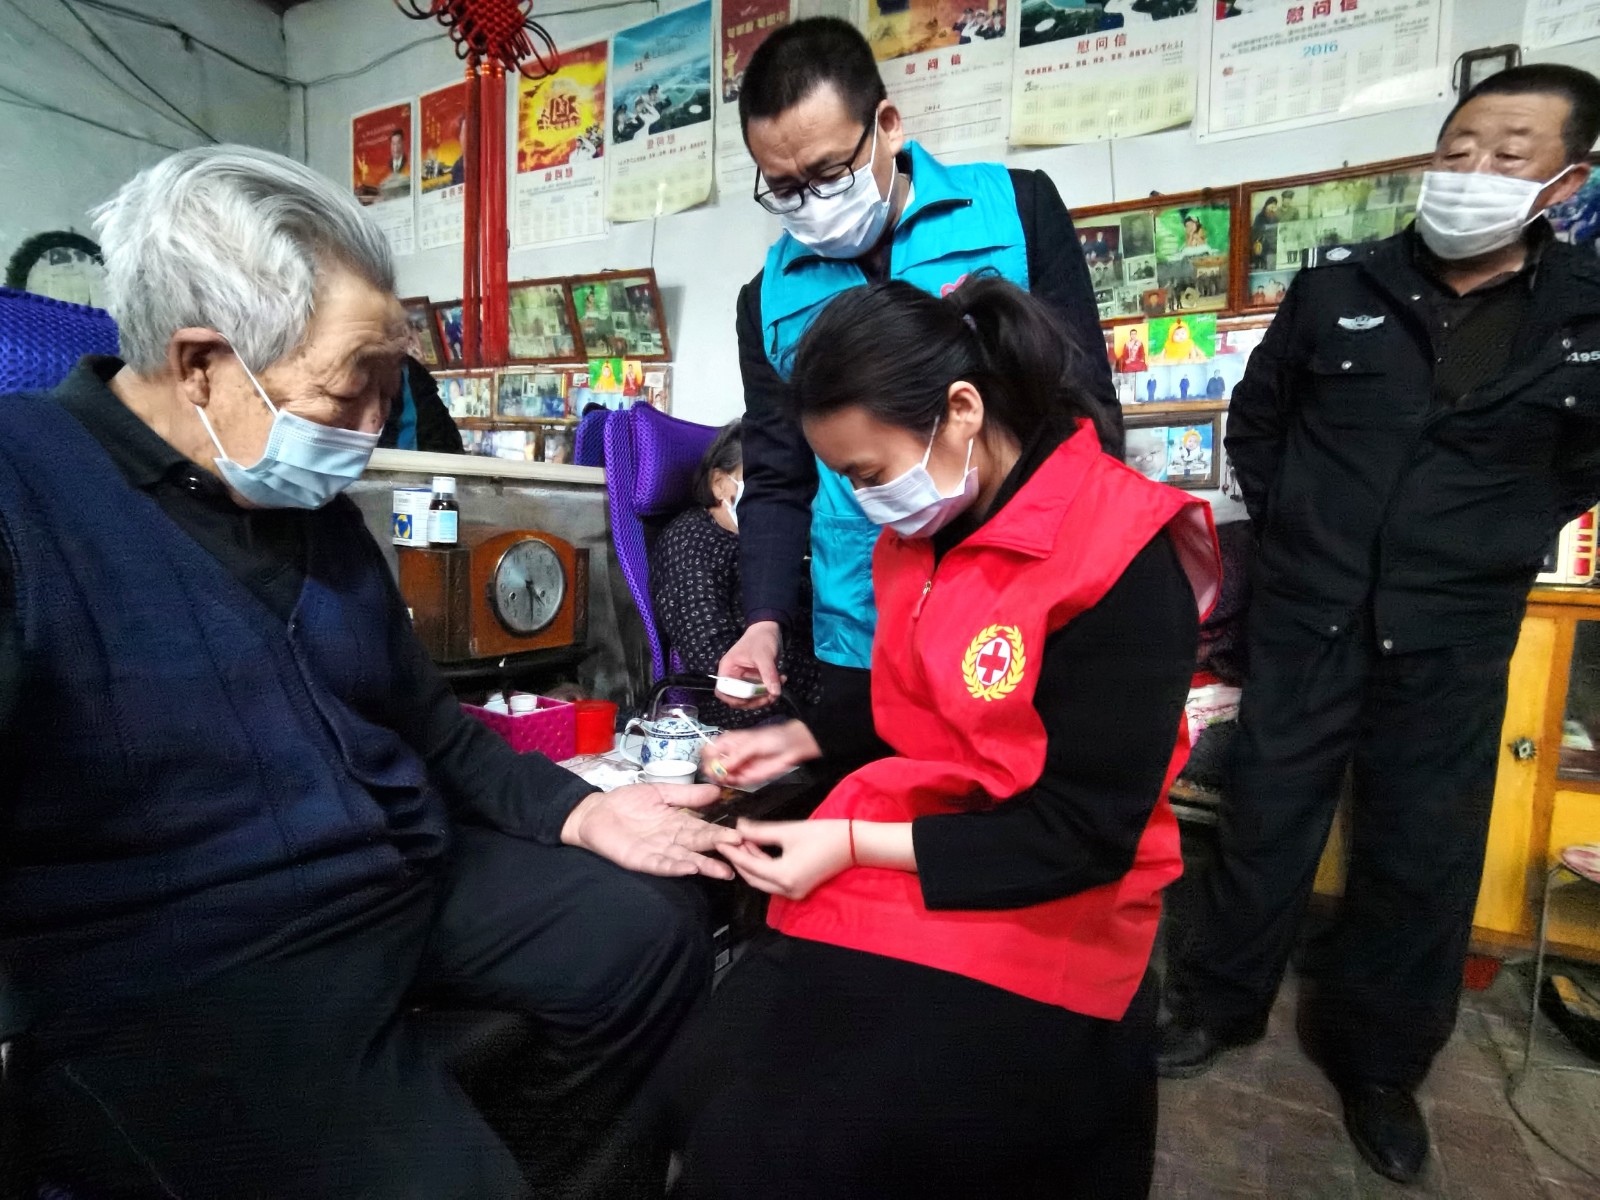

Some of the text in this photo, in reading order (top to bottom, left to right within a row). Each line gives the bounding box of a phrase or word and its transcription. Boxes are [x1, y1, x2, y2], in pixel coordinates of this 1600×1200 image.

[1286, 0, 1358, 25] 慰问信
[1076, 33, 1128, 55] 慰问信
[1303, 40, 1339, 58] 2016
[904, 53, 962, 75] 慰问信
